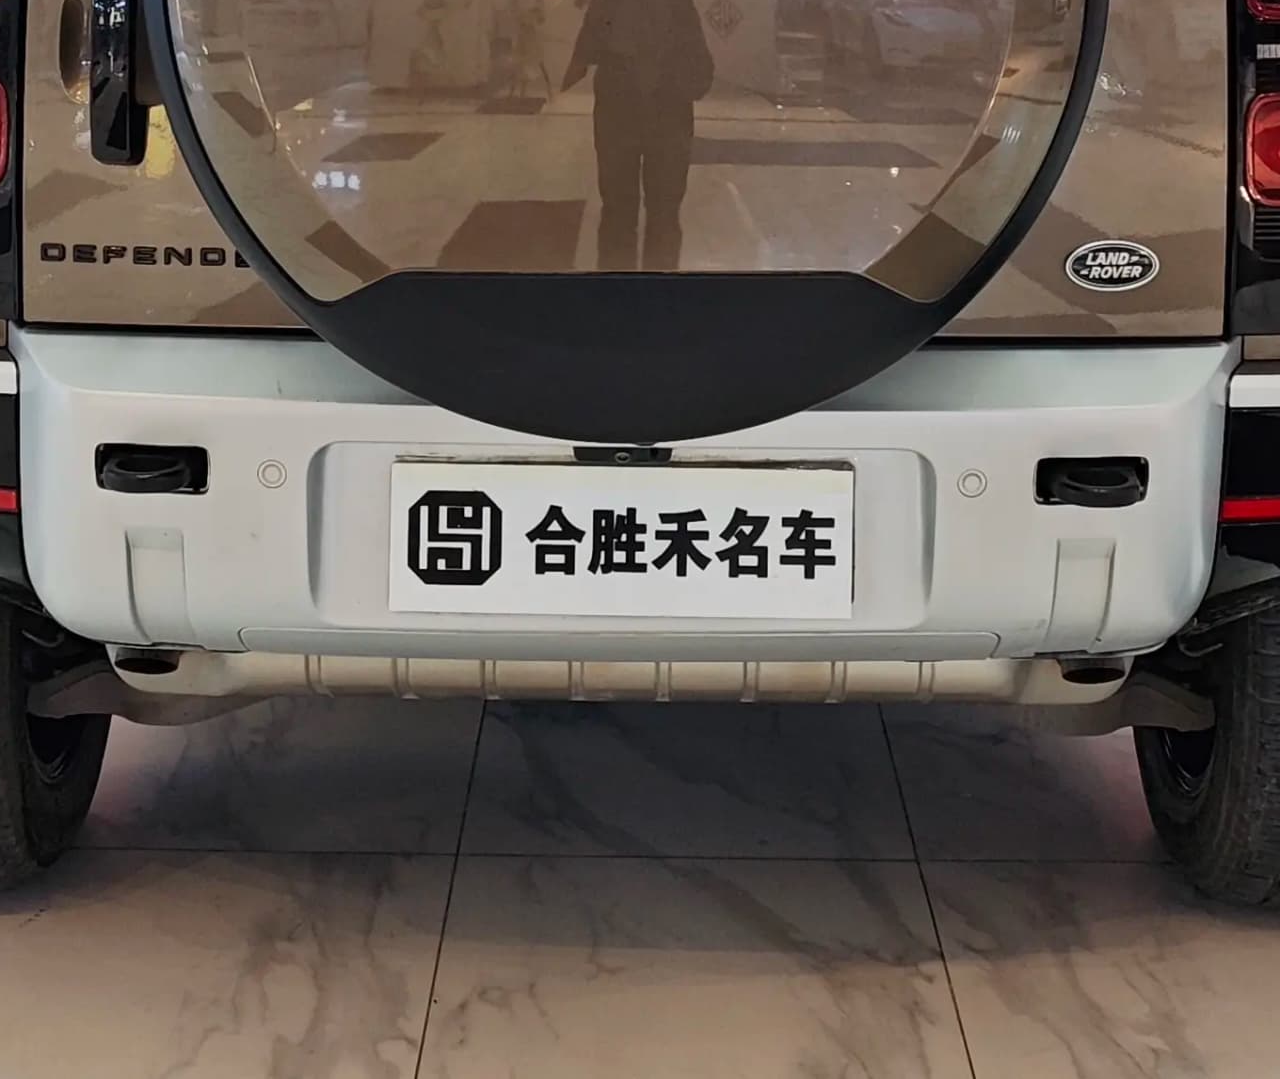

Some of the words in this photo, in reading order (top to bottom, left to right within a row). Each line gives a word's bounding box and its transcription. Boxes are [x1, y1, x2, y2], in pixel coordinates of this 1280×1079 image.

[1085, 251, 1130, 266] LAND
[1088, 265, 1144, 279] ROVER
[525, 504, 837, 580] 合胜禾名车
